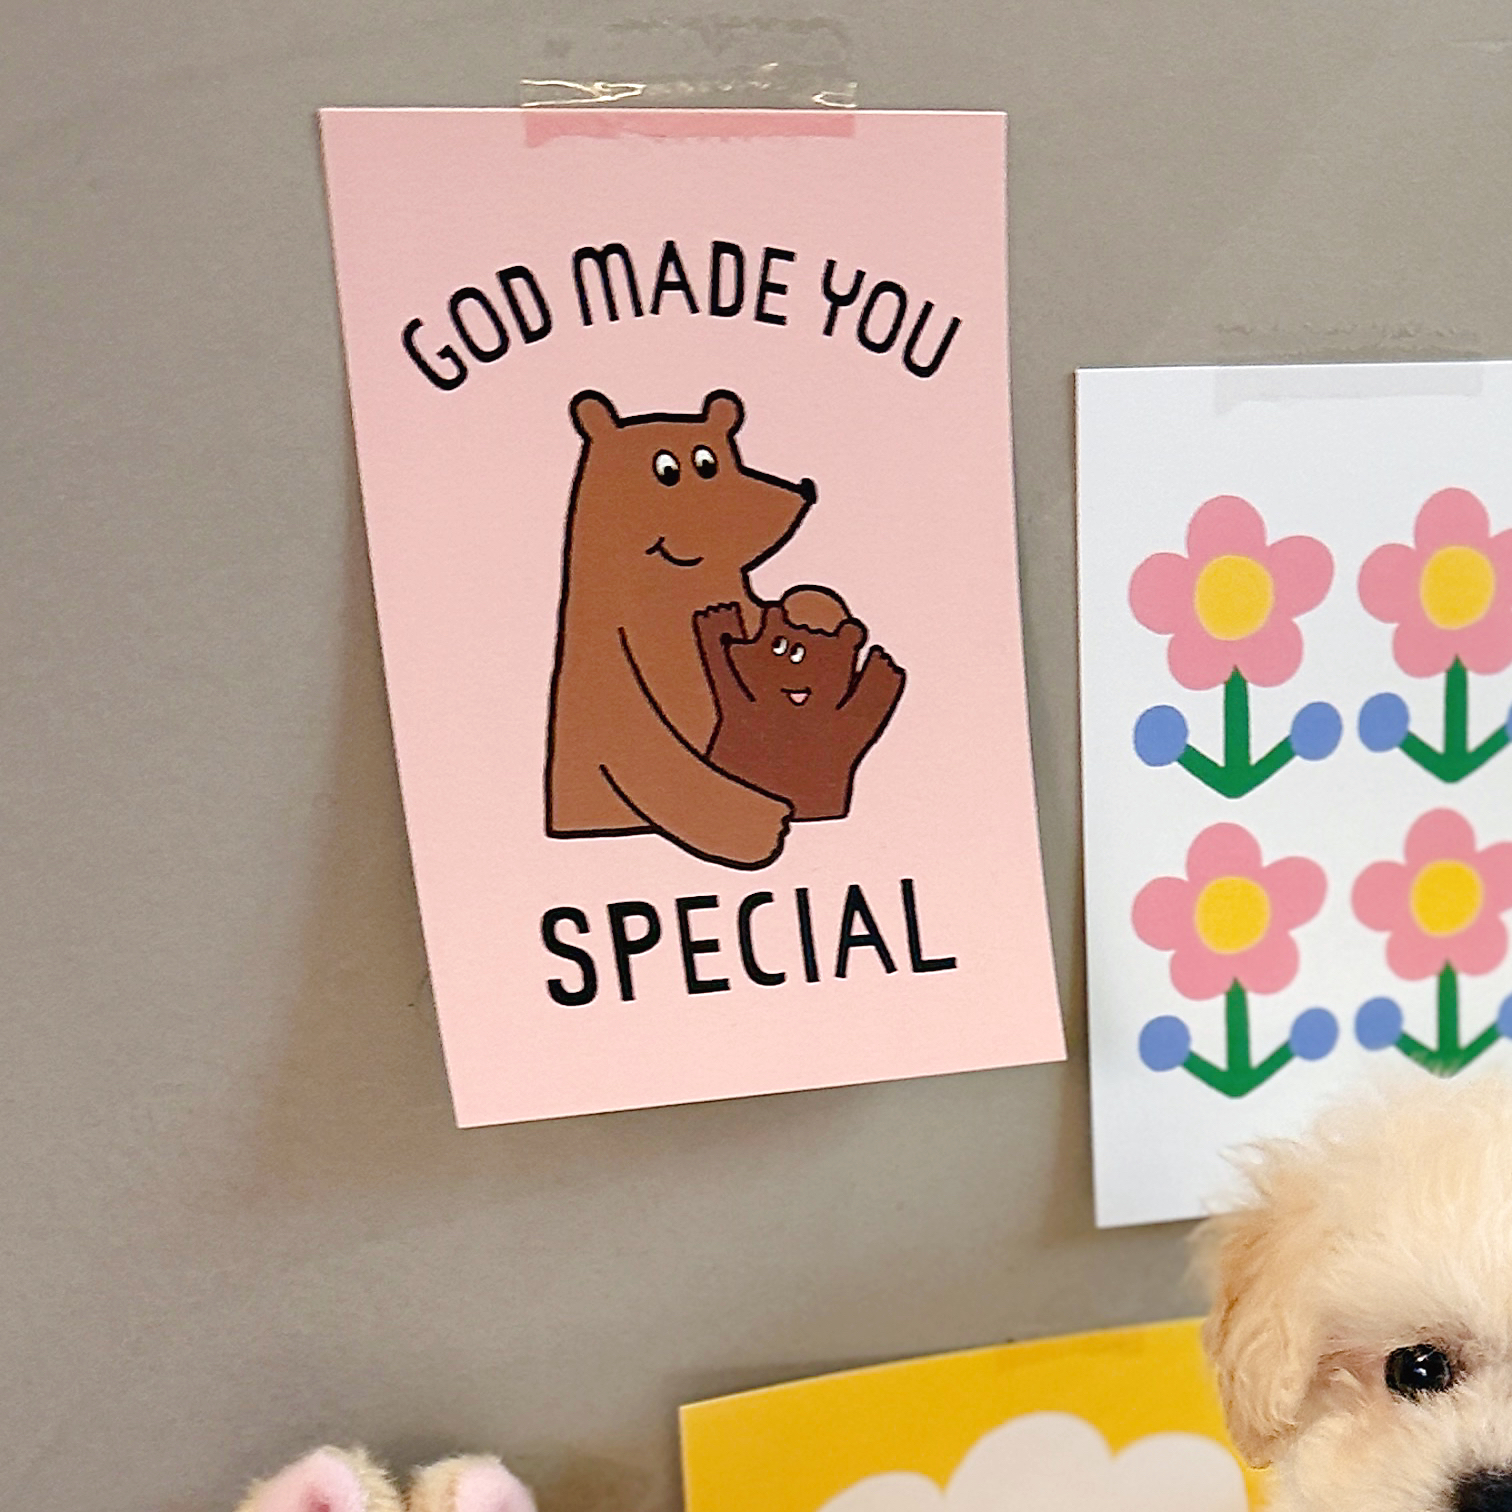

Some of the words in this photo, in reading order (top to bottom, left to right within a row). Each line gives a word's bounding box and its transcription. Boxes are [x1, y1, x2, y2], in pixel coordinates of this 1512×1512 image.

[401, 264, 553, 392] GOD
[571, 239, 797, 328] MADE
[821, 258, 963, 380] YOU
[539, 877, 959, 1008] SPECIAL
